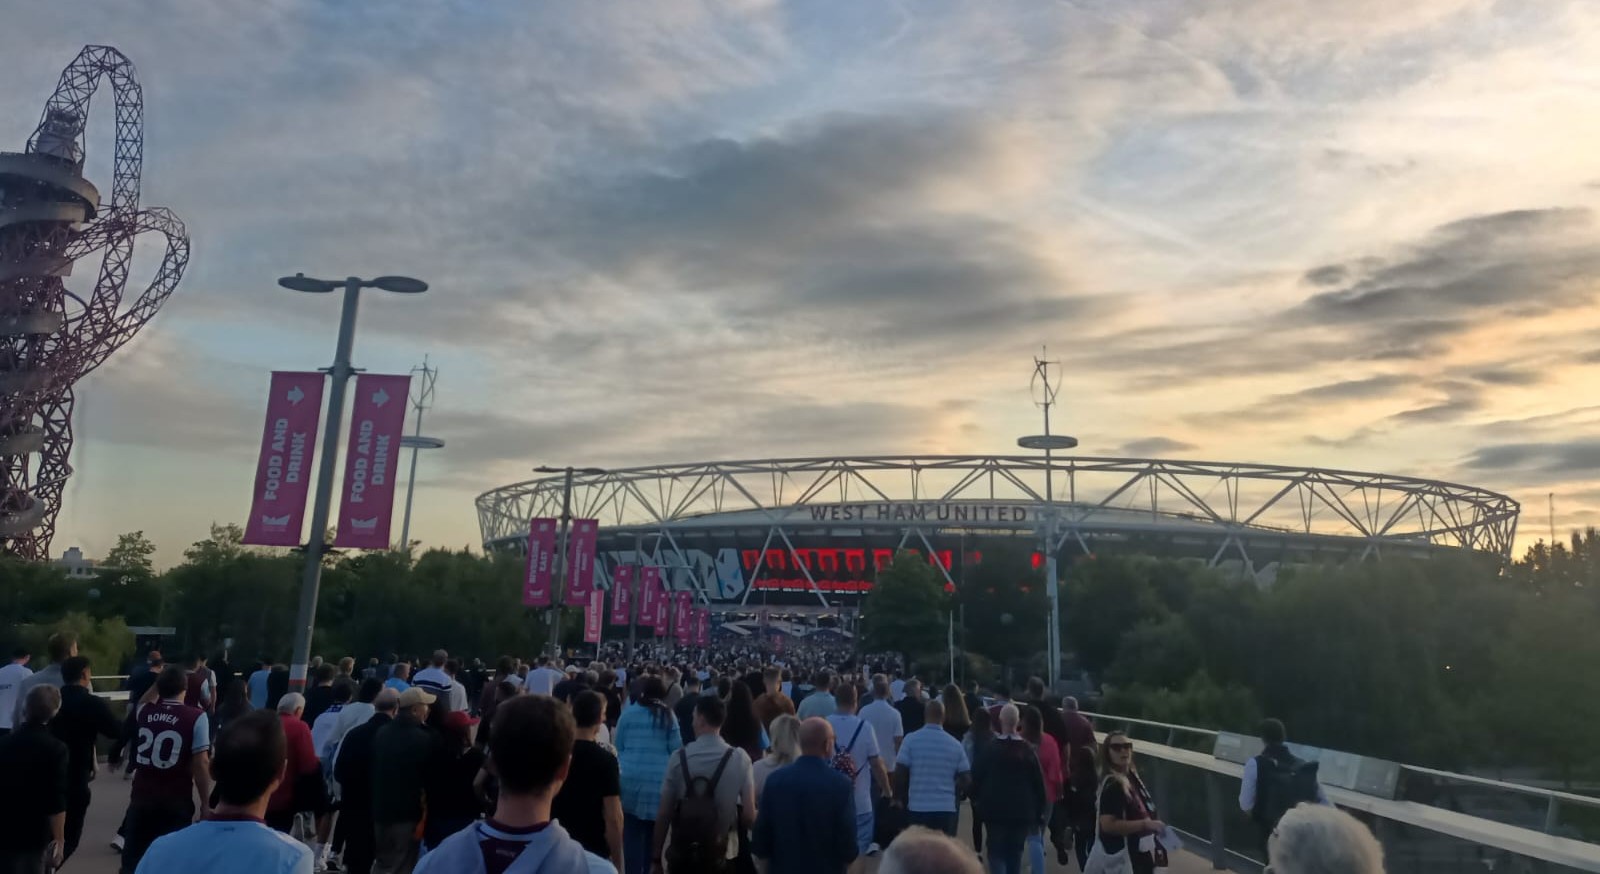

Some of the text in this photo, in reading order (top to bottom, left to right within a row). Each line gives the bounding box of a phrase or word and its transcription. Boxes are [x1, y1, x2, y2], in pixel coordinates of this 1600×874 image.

[264, 418, 289, 500] FOOD AND
[286, 432, 306, 483] DRINK
[350, 420, 374, 503] FOOD AND
[371, 435, 391, 485] DRINK
[810, 504, 1027, 521] WEST HAM UNITED
[147, 712, 179, 726] BOWEN
[136, 727, 183, 769] 20
